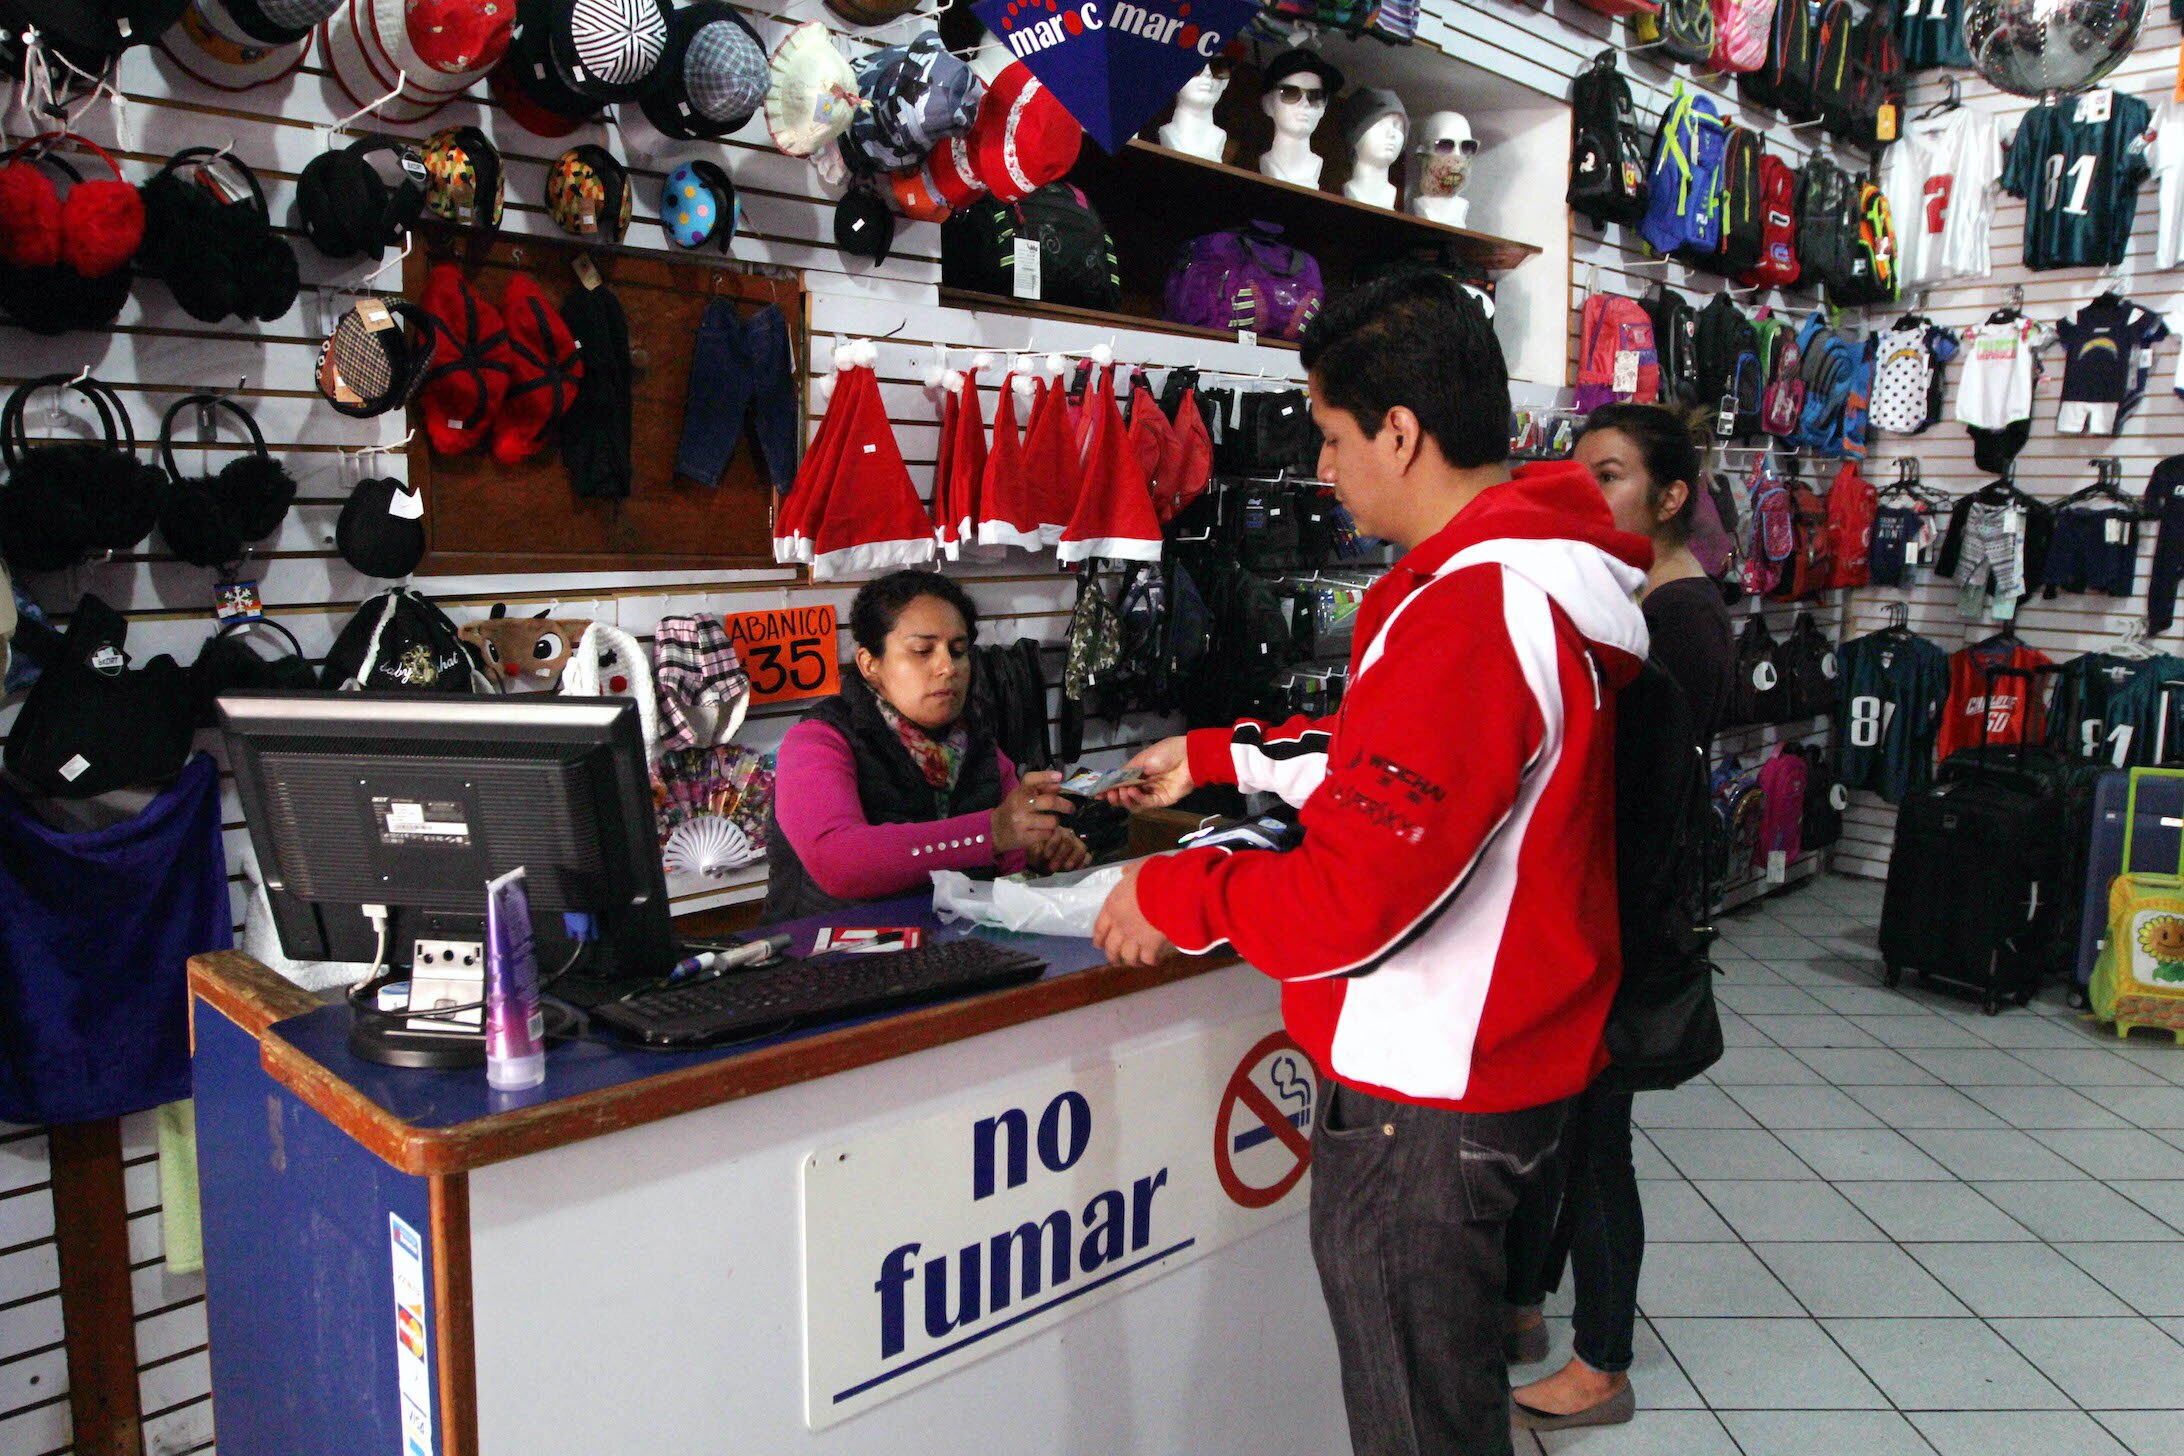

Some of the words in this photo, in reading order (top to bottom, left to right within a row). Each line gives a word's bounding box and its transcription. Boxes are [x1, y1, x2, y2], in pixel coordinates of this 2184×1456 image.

[2045, 154, 2097, 215] 81
[731, 607, 832, 644] ABANICO
[741, 638, 827, 694] 35
[972, 1090, 1092, 1202] no
[873, 1166, 1169, 1360] fumar
